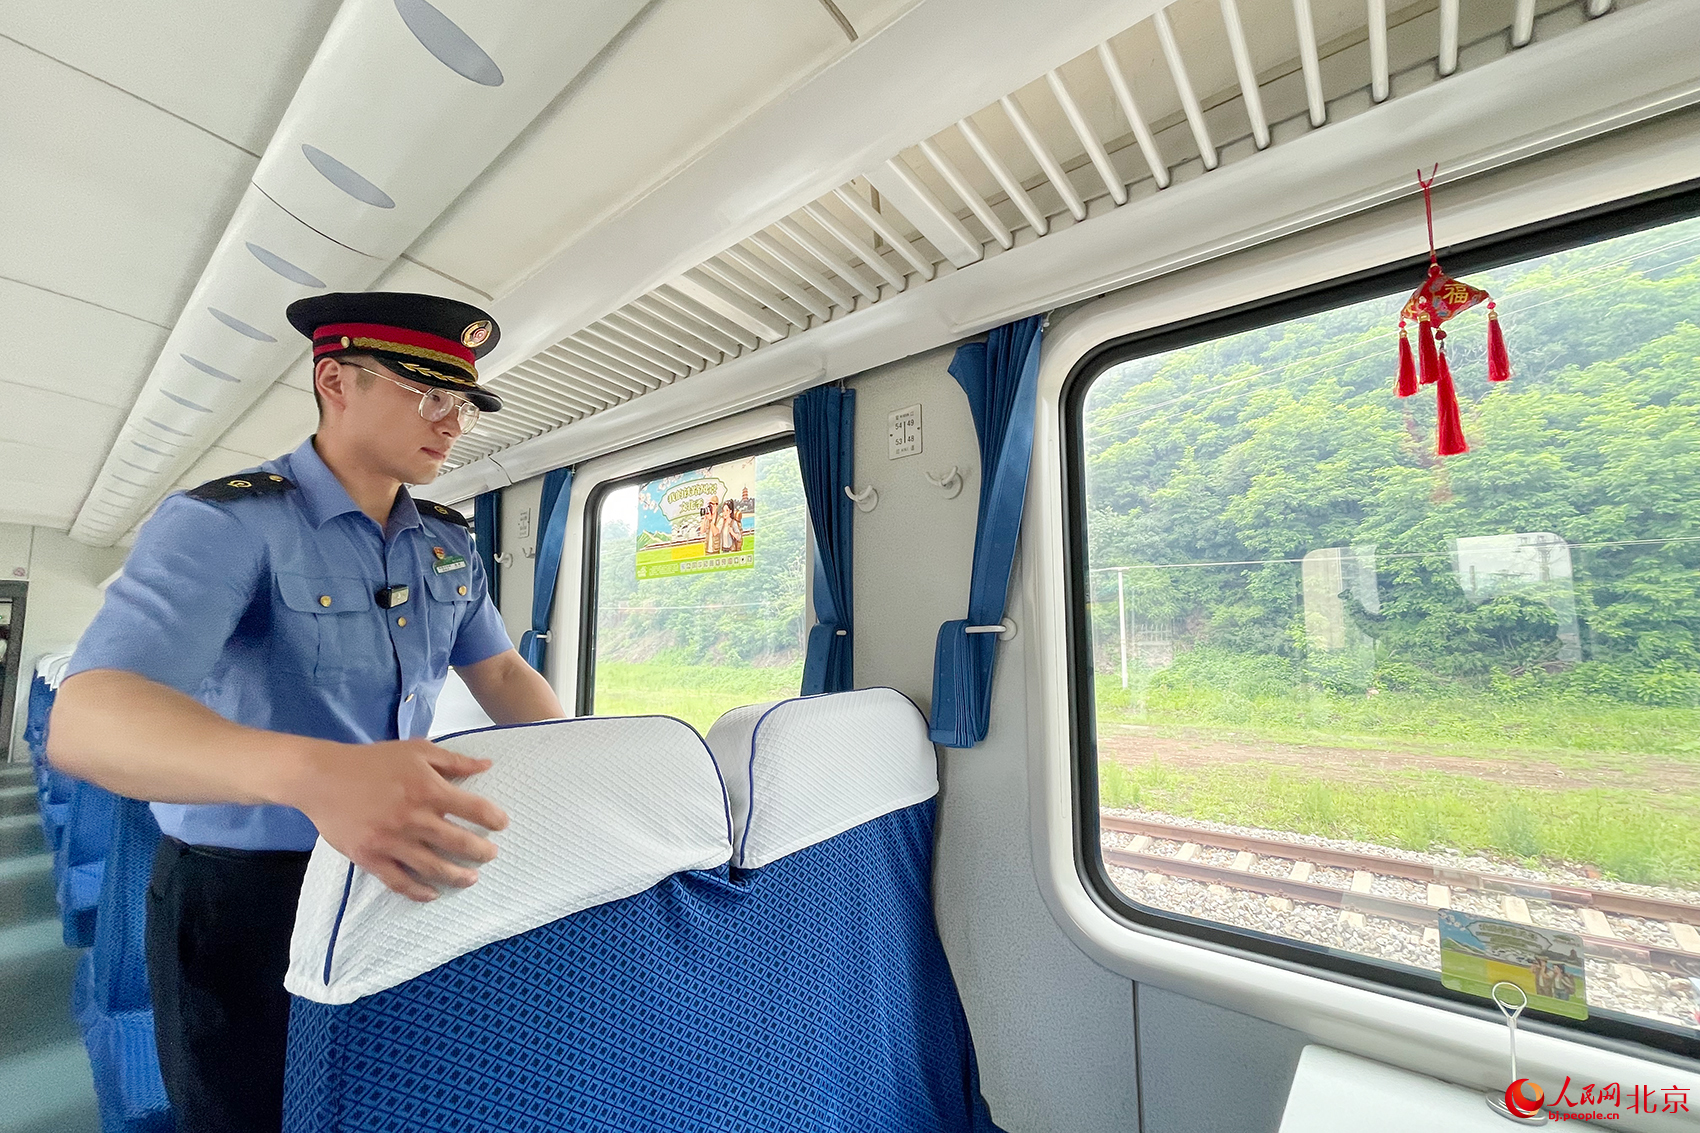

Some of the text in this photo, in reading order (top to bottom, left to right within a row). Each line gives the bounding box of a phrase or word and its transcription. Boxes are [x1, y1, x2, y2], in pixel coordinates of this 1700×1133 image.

[1443, 283, 1468, 304] 福
[895, 419, 915, 430] 54 49
[895, 438, 903, 446] 53
